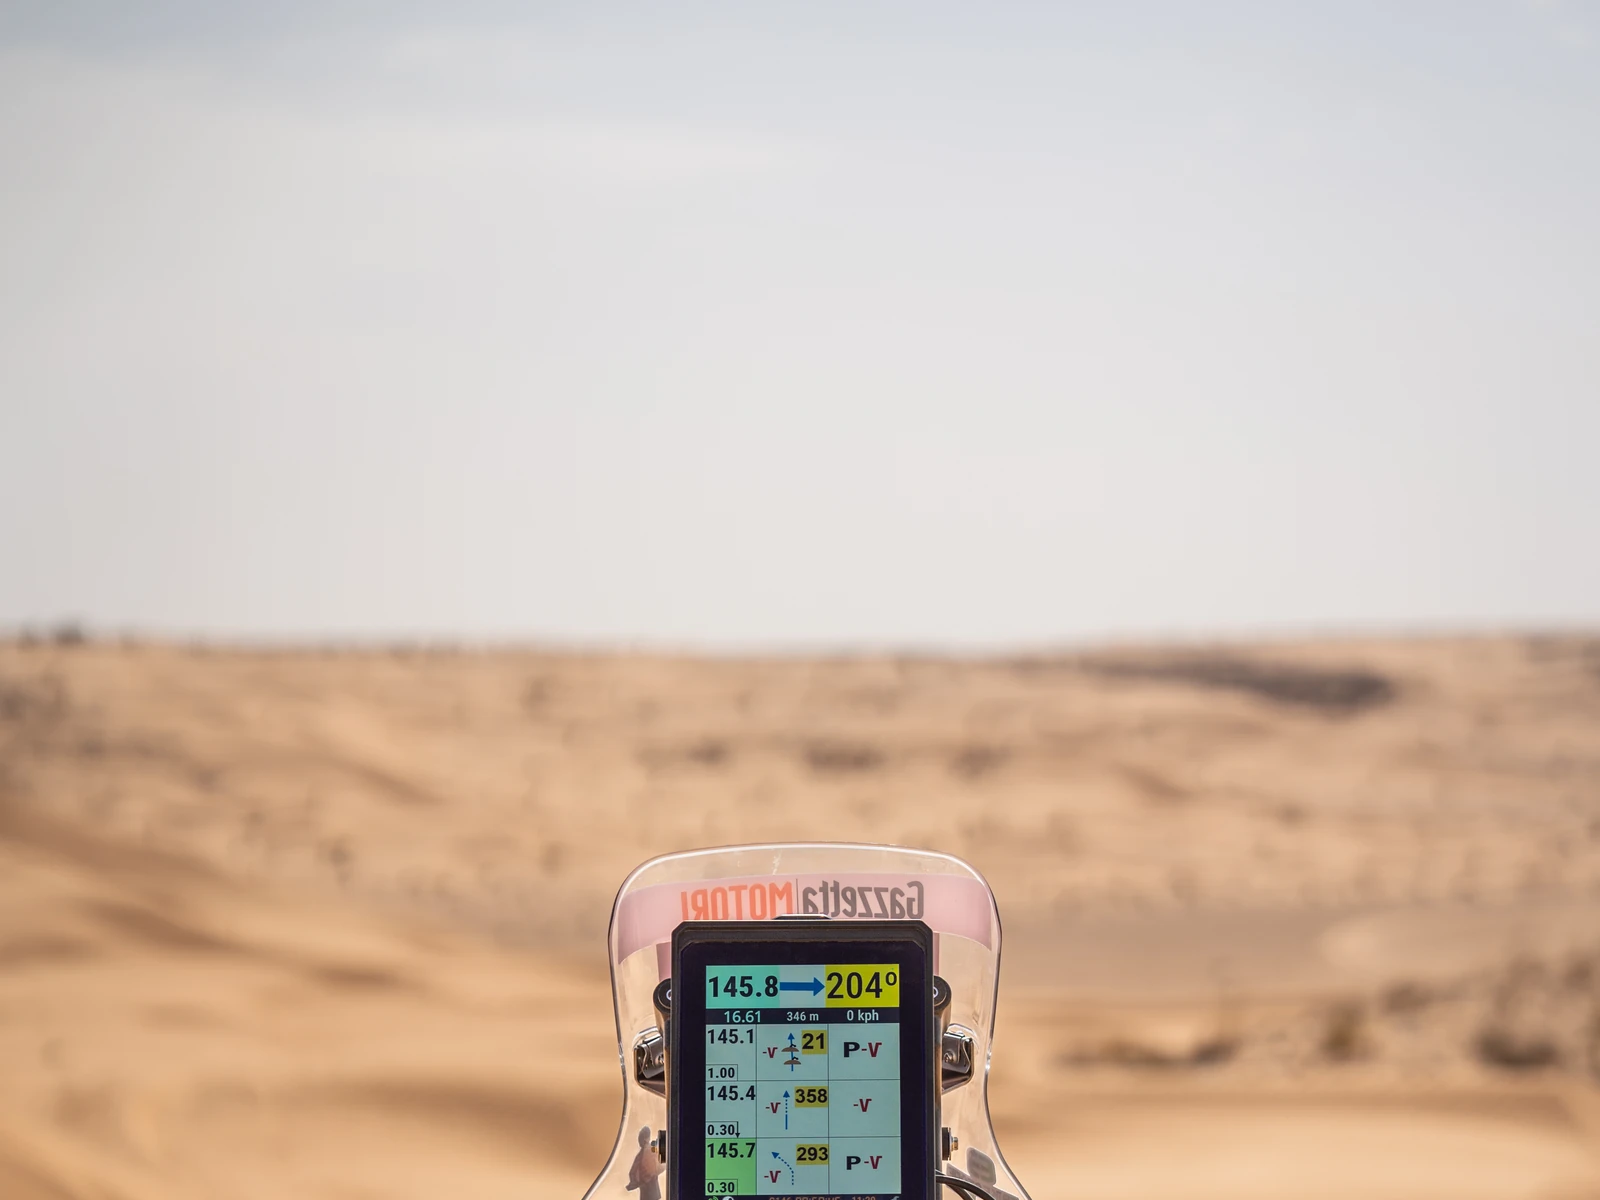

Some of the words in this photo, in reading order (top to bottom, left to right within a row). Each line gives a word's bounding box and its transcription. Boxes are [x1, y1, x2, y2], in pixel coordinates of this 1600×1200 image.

[708, 975, 779, 998] 145.8
[826, 971, 898, 999] 204°
[724, 1010, 761, 1023] 16.61
[786, 1011, 807, 1022] 346
[809, 1013, 819, 1022] m
[846, 1009, 854, 1021] 0
[857, 1009, 879, 1024] kph
[707, 1028, 754, 1044] 145.1
[802, 1032, 825, 1050] 21
[707, 1067, 736, 1079] 1.00
[707, 1085, 756, 1101] 145.4
[795, 1088, 828, 1104] 358
[707, 1124, 735, 1136] 0.30
[707, 1142, 756, 1158] 145.7
[796, 1146, 829, 1161] 293
[707, 1181, 735, 1193] 0.30
